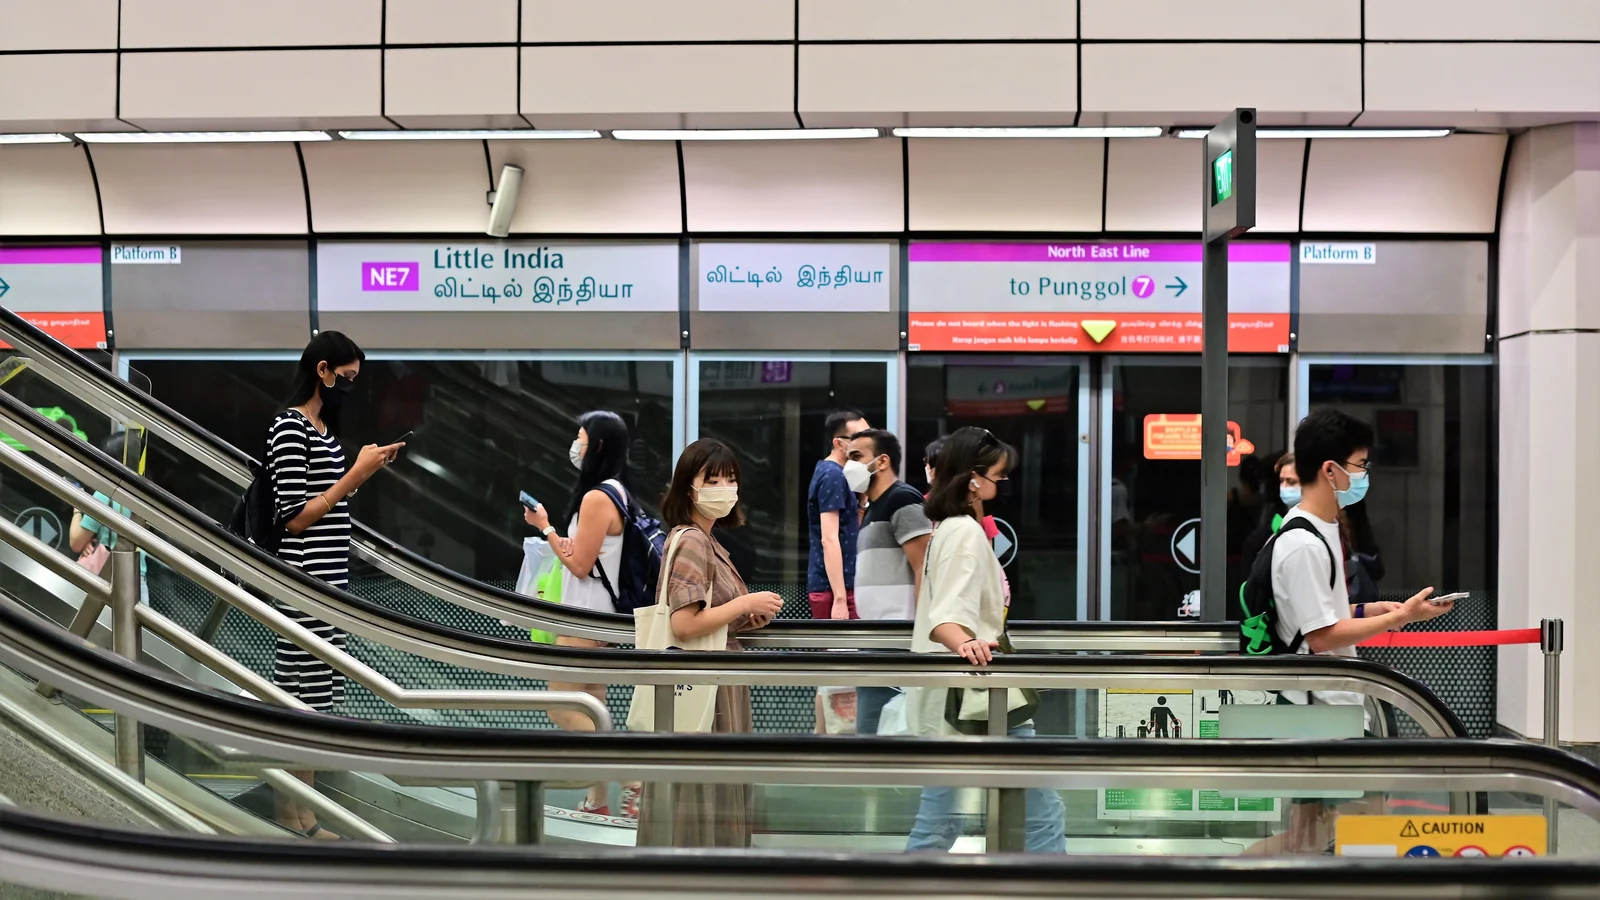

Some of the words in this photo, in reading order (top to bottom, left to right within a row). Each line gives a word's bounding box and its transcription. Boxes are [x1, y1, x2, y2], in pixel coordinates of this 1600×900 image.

[114, 246, 165, 260] Platform
[169, 247, 177, 260] B
[433, 246, 494, 270] Little
[504, 246, 564, 270] India
[1047, 245, 1086, 258] North
[1091, 245, 1119, 258] East
[1123, 245, 1150, 258] Line
[1303, 245, 1359, 260] Platform
[1364, 247, 1372, 260] B
[370, 267, 411, 287] NE7
[706, 264, 783, 288] லிட்டில்
[796, 264, 884, 290] இந்தியா
[433, 276, 523, 304] லிட்டில்
[532, 276, 634, 305] இந்தியா
[1009, 277, 1030, 296] to
[1039, 276, 1127, 300] Punggol
[1136, 277, 1151, 296] 7
[911, 319, 935, 327] Please
[936, 319, 946, 327] do
[948, 319, 961, 327] not
[962, 319, 984, 327] board
[986, 319, 1007, 327] when
[1008, 319, 1021, 327] the
[1022, 319, 1039, 329] light
[1040, 319, 1047, 327] is
[1048, 319, 1078, 329] flashing
[952, 336, 973, 345] Harap
[973, 336, 996, 345] jangan
[1422, 822, 1485, 835] CAUTION
